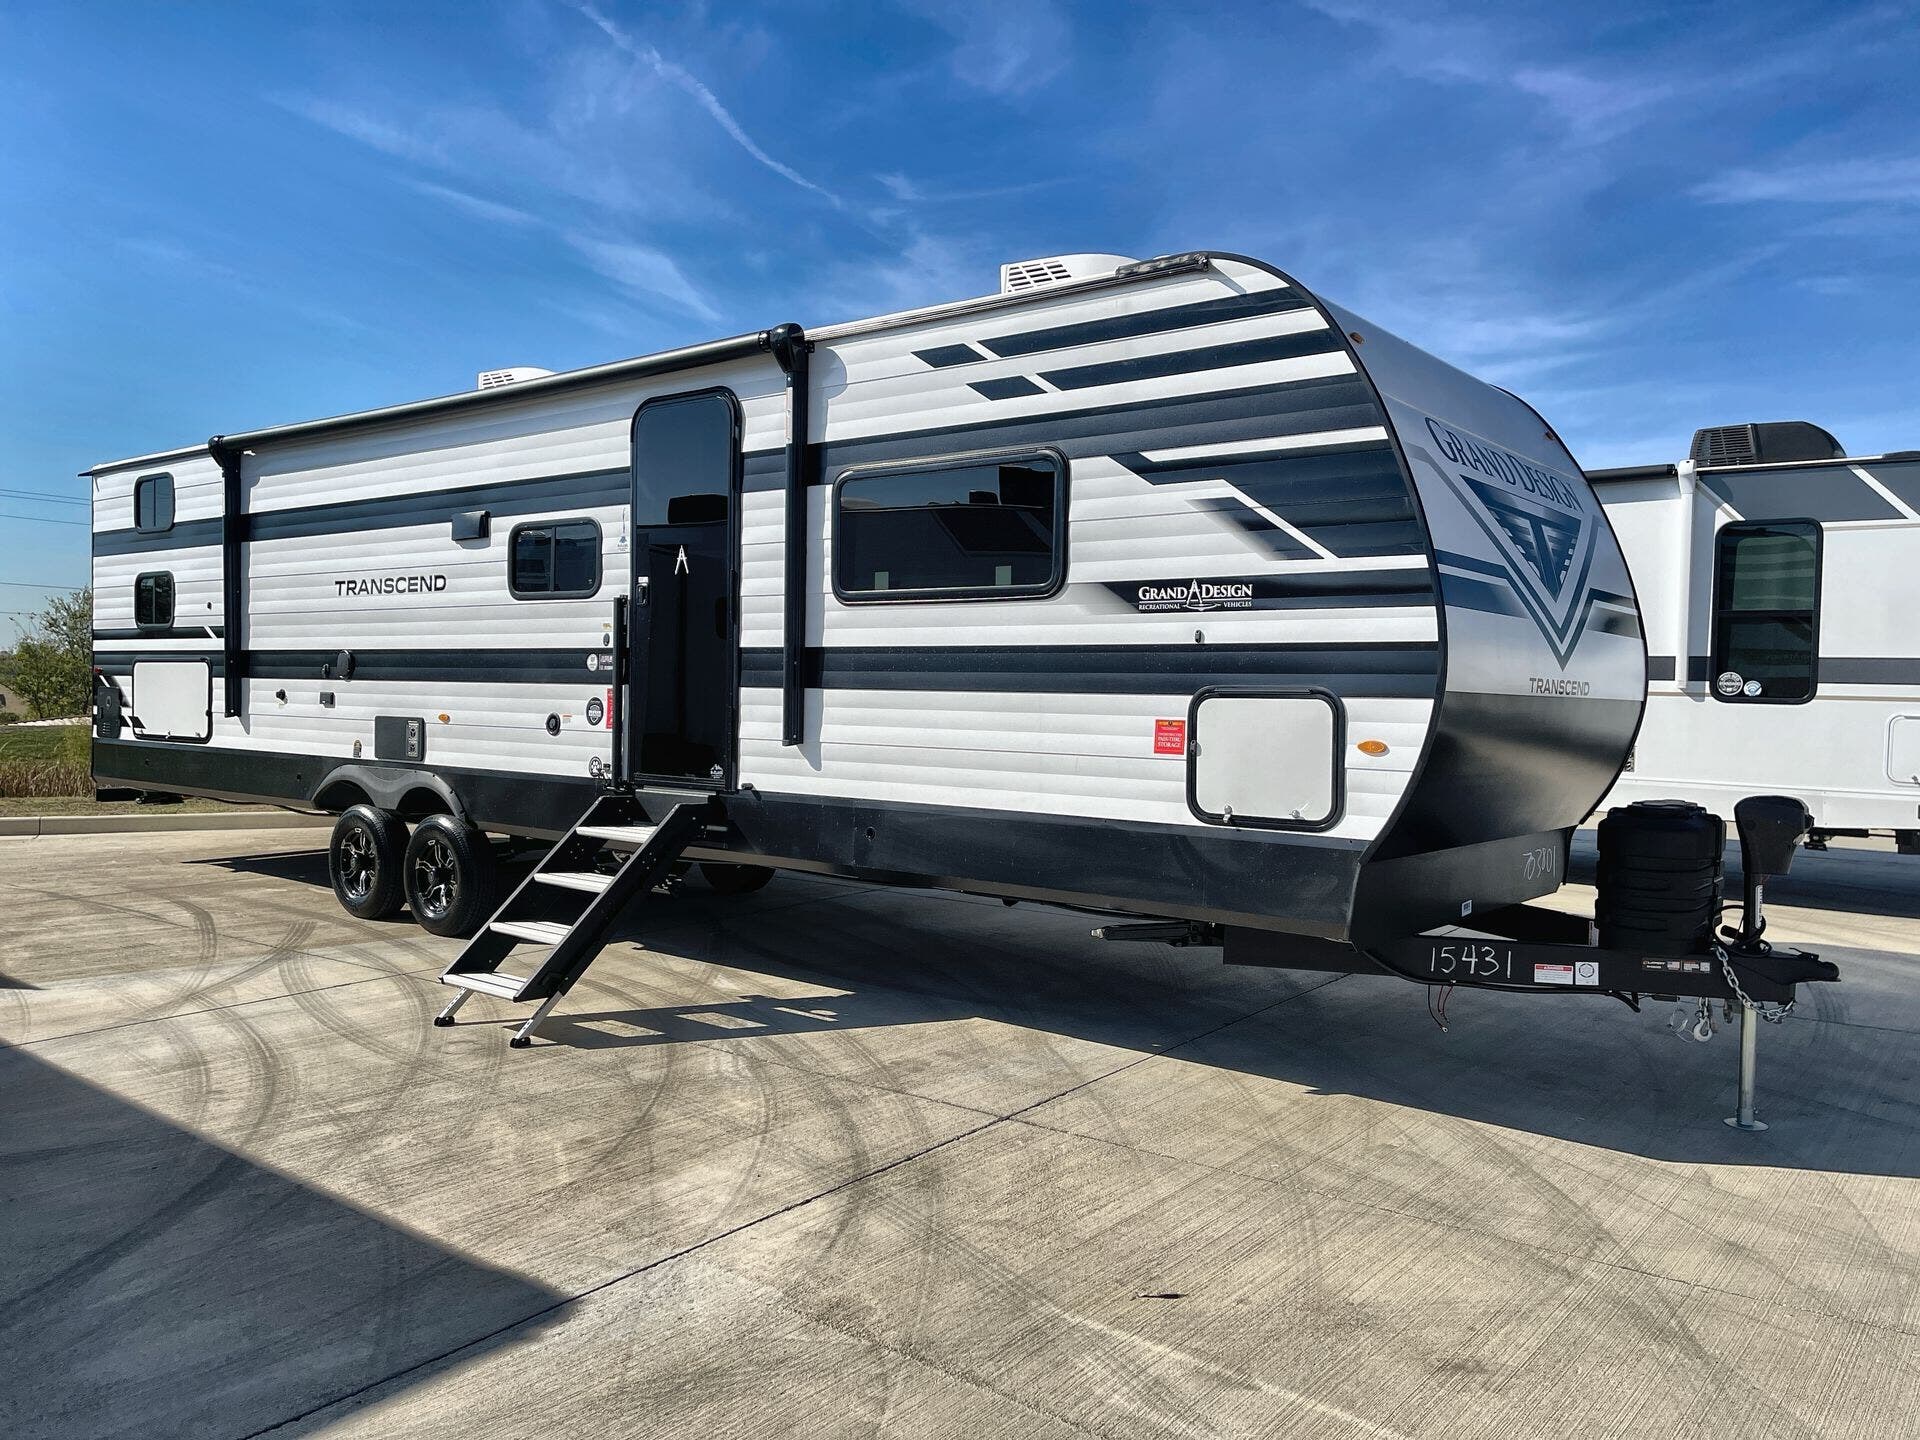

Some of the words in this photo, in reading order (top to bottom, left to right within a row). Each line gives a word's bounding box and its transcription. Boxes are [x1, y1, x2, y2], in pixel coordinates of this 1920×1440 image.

[1424, 416, 1517, 486] GRAND
[1504, 453, 1585, 513] DESIGN
[334, 574, 447, 596] TRANSCEND
[1138, 586, 1188, 600] GRAND
[1200, 583, 1253, 598] DESIGN
[1529, 677, 1590, 696] TRANSCEND
[1430, 944, 1512, 979] 15431
